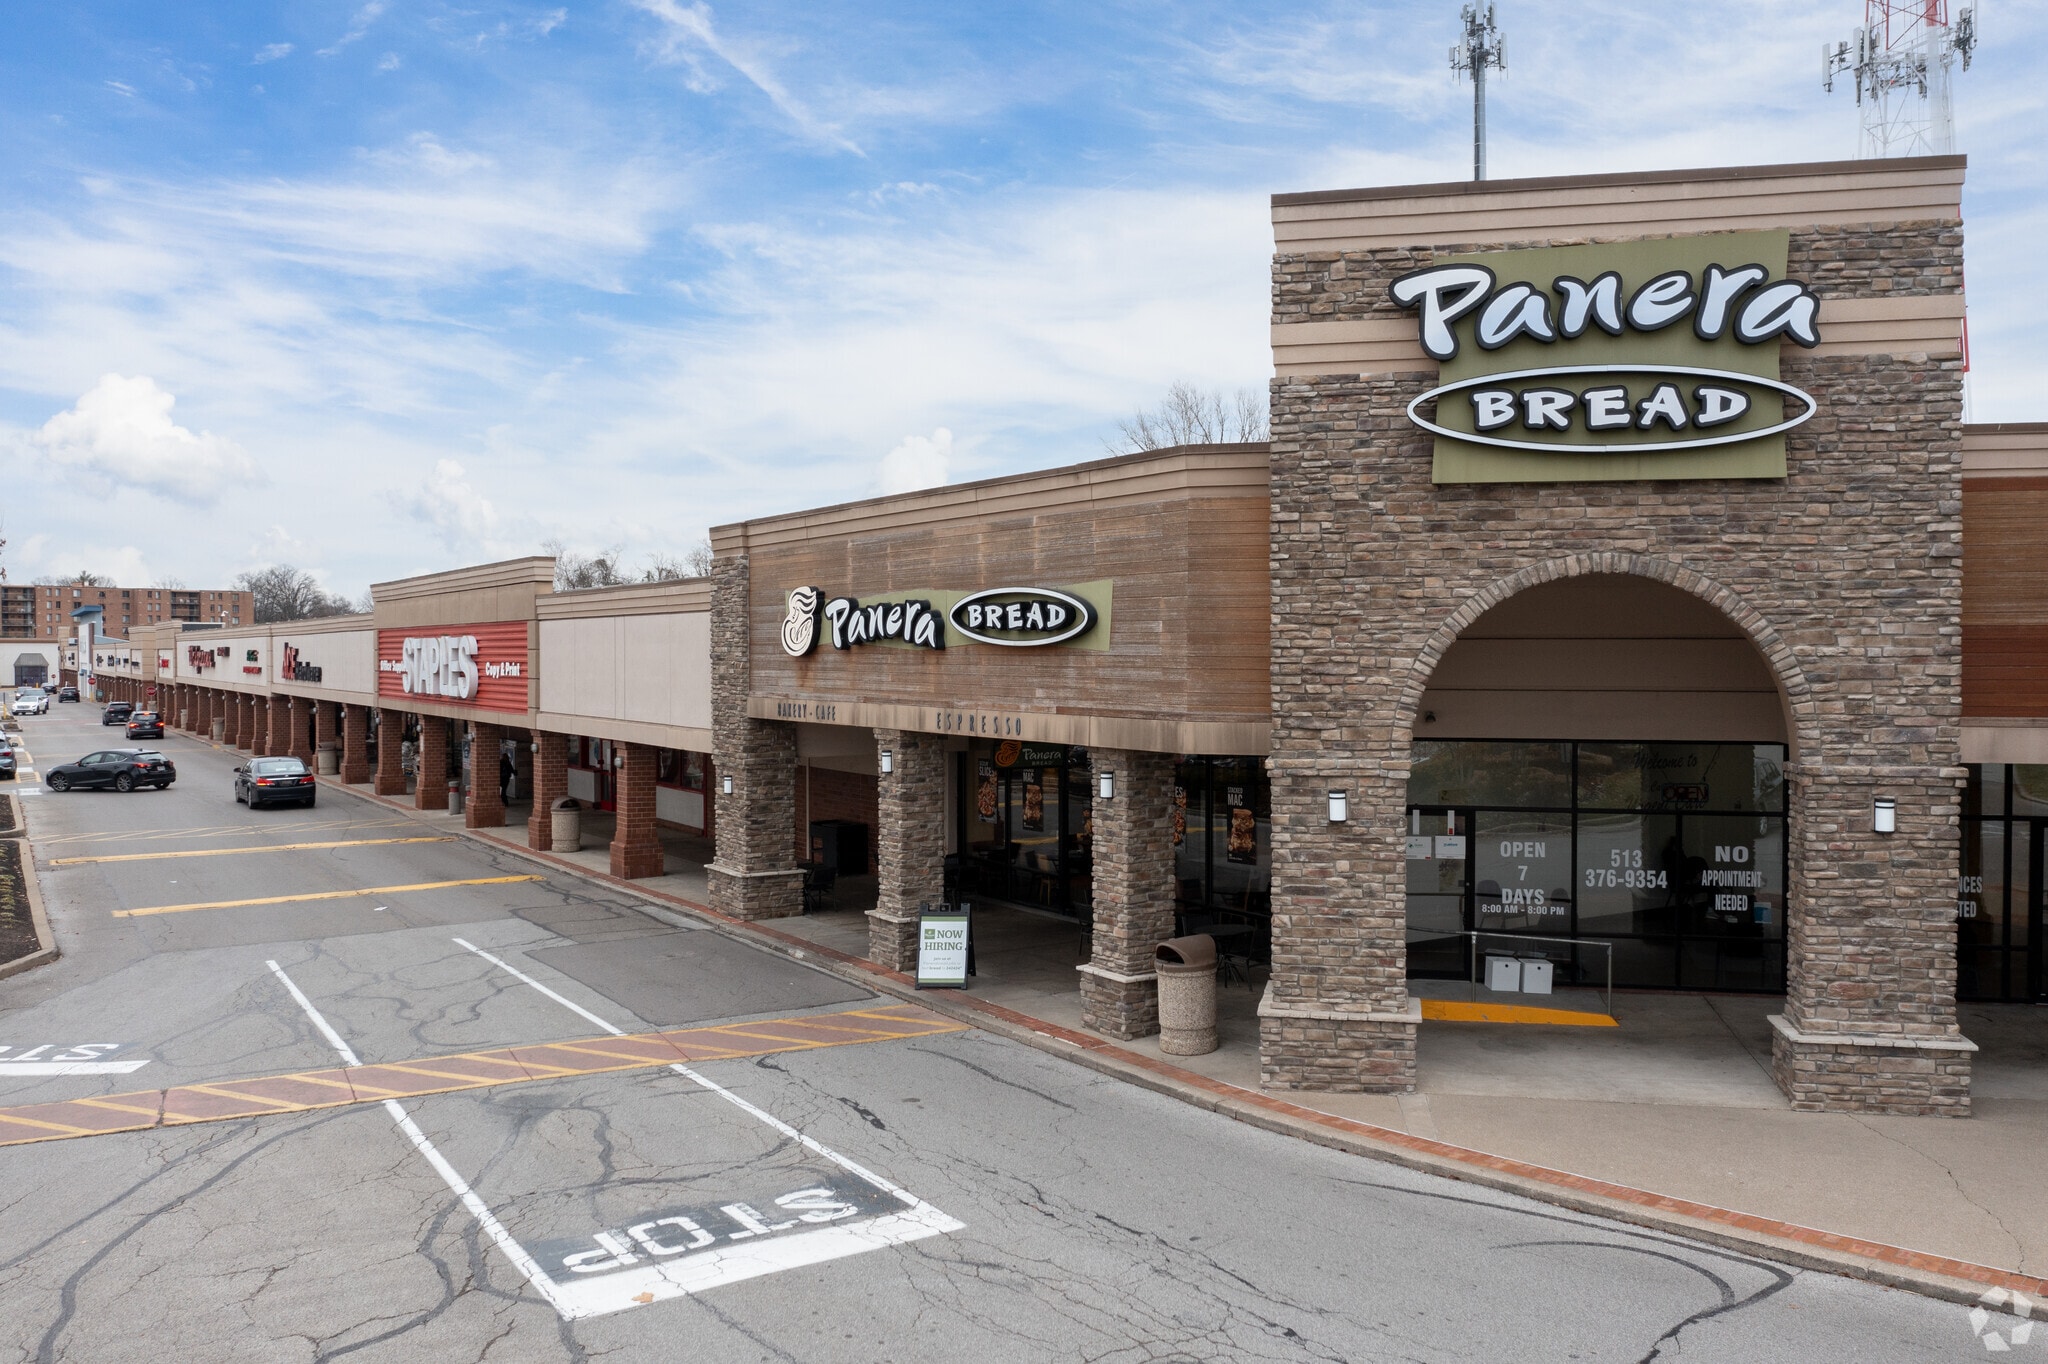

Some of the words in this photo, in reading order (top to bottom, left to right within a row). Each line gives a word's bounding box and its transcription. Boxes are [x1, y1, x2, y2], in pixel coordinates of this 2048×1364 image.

[1390, 263, 1820, 360] Panera
[1470, 382, 1751, 431] BREAD
[825, 597, 943, 650] Panera
[967, 602, 1069, 630] BREAD
[402, 635, 478, 699] STAPLES
[485, 661, 500, 679] Copy
[505, 661, 520, 677] Print
[777, 702, 807, 718] BAKERY
[815, 704, 836, 721] CAFE
[936, 712, 1022, 736] ESPRESSO
[1022, 748, 1061, 760] Panera
[1687, 753, 1698, 768] to
[1174, 786, 1184, 798] ES
[1227, 793, 1243, 807] MAC
[1663, 785, 1708, 800] OPEN
[1500, 841, 1546, 858] OPEN
[1610, 849, 1642, 868] 513
[1715, 845, 1749, 863] NO
[1517, 865, 1528, 881] 7
[1585, 869, 1668, 889] 376-9354
[1701, 869, 1762, 888] APPOINTMENT
[1958, 875, 1983, 893] NCES
[1501, 888, 1545, 905] DAYS
[1715, 894, 1748, 911] NEEDED
[1481, 904, 1502, 914] 8:00
[1503, 905, 1518, 914] AM
[1527, 906, 1547, 915] 8:00
[1550, 906, 1565, 916] PM
[1958, 900, 1977, 918] TED
[937, 930, 963, 939] NOW
[924, 941, 963, 951] HIRING
[0, 1043, 119, 1062] ST
[563, 1188, 859, 1273] STOP
